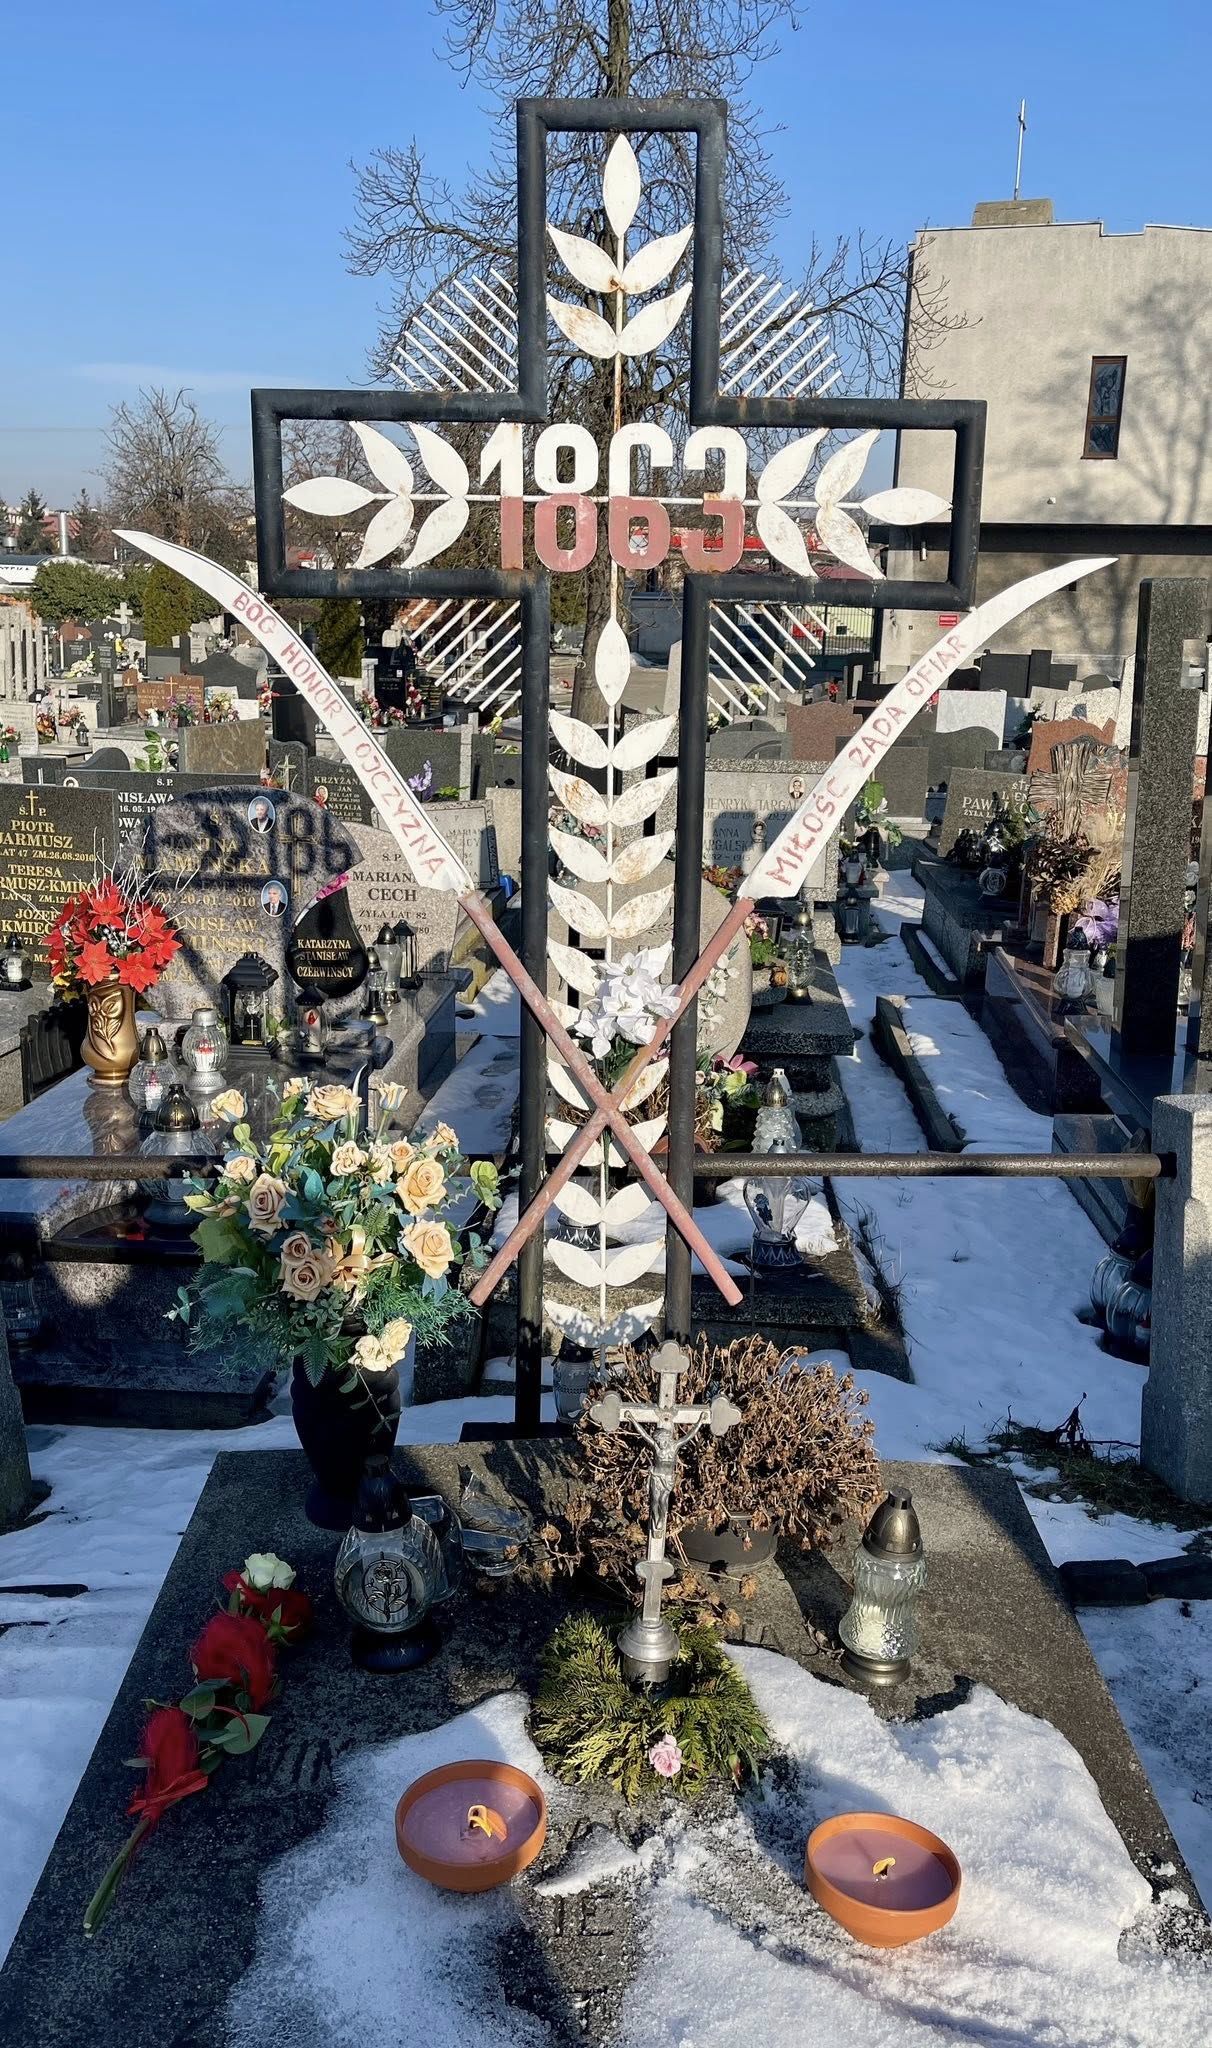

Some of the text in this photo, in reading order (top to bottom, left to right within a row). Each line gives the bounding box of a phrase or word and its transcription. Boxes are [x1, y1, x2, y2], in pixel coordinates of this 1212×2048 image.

[480, 420, 747, 572] 1863
[905, 635, 968, 696] OFIAR
[280, 641, 343, 719] HONOR
[355, 742, 446, 874] OJCZYZNA
[11, 819, 55, 833] PIOTR
[8, 864, 63, 878] TERESA
[368, 888, 417, 902] CECH
[297, 939, 352, 949] KATARZYNA
[299, 951, 350, 961] STANISŁAW
